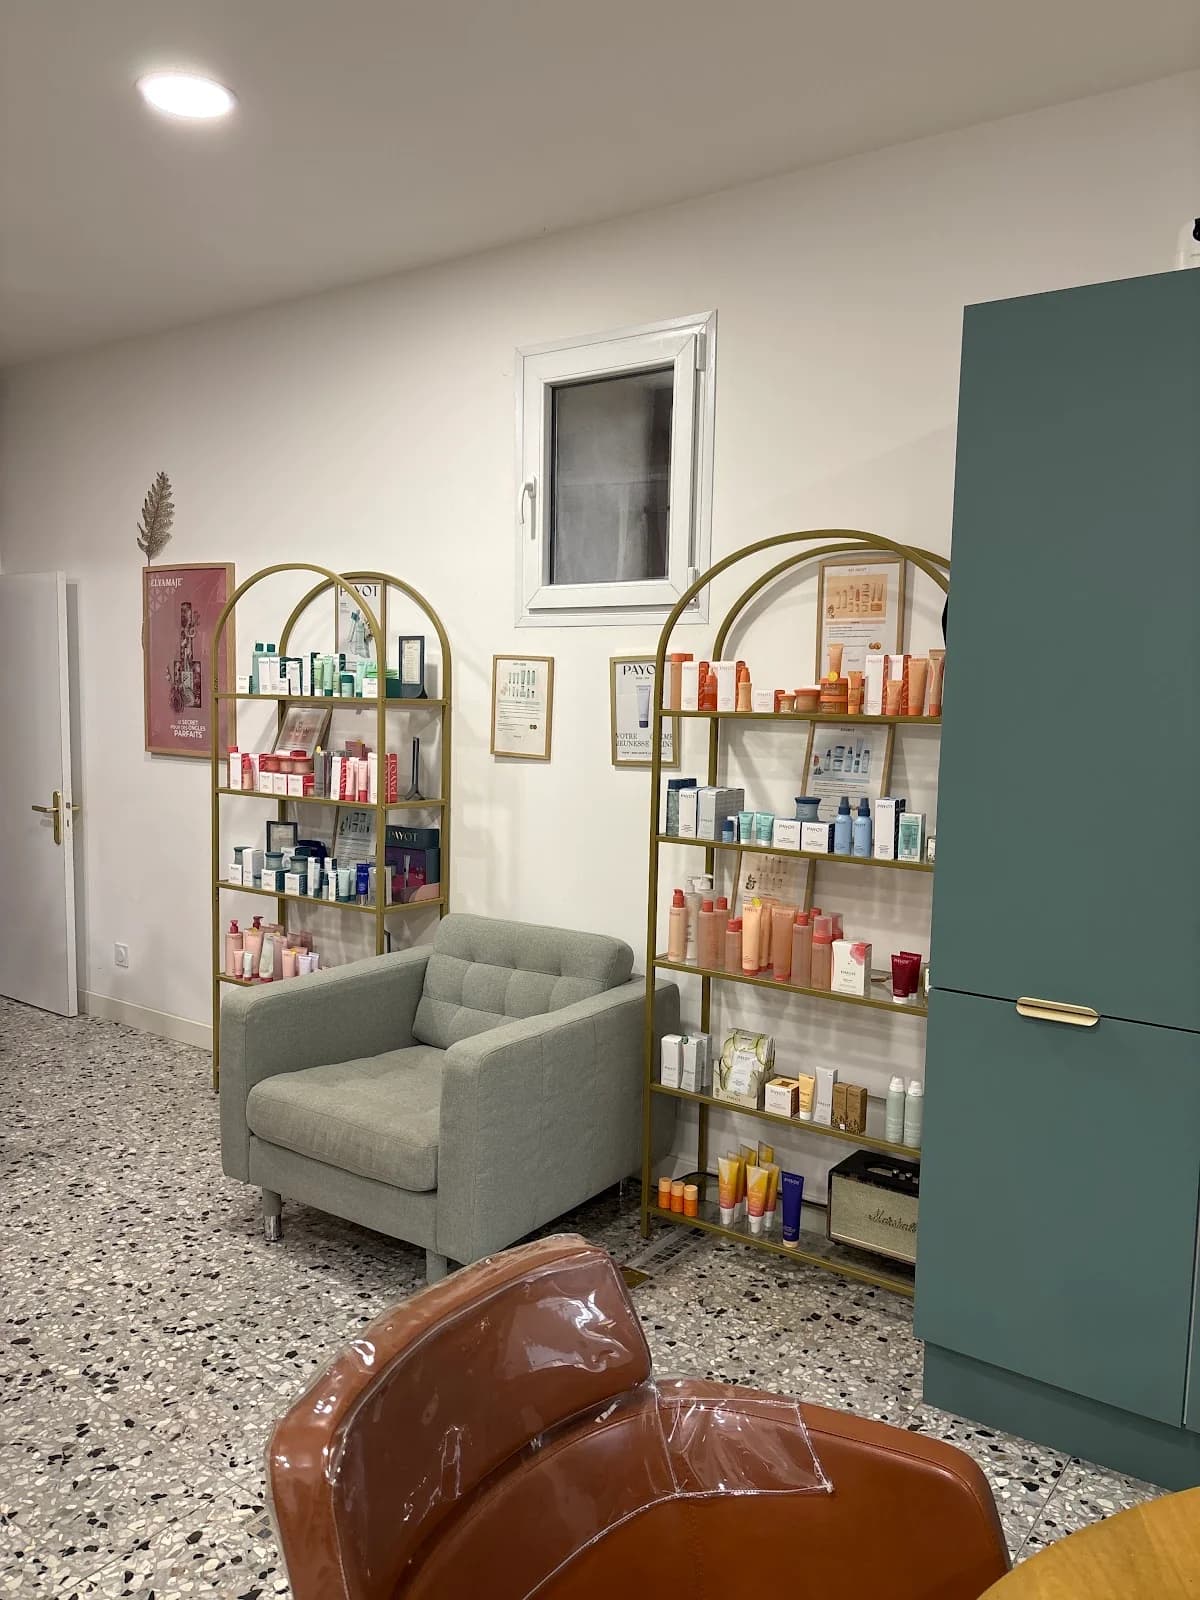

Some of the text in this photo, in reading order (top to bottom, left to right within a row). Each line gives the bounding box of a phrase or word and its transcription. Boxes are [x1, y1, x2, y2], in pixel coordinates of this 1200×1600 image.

[340, 585, 379, 597] PYOT
[623, 664, 656, 676] PAYO
[174, 729, 203, 739] PARFAITS
